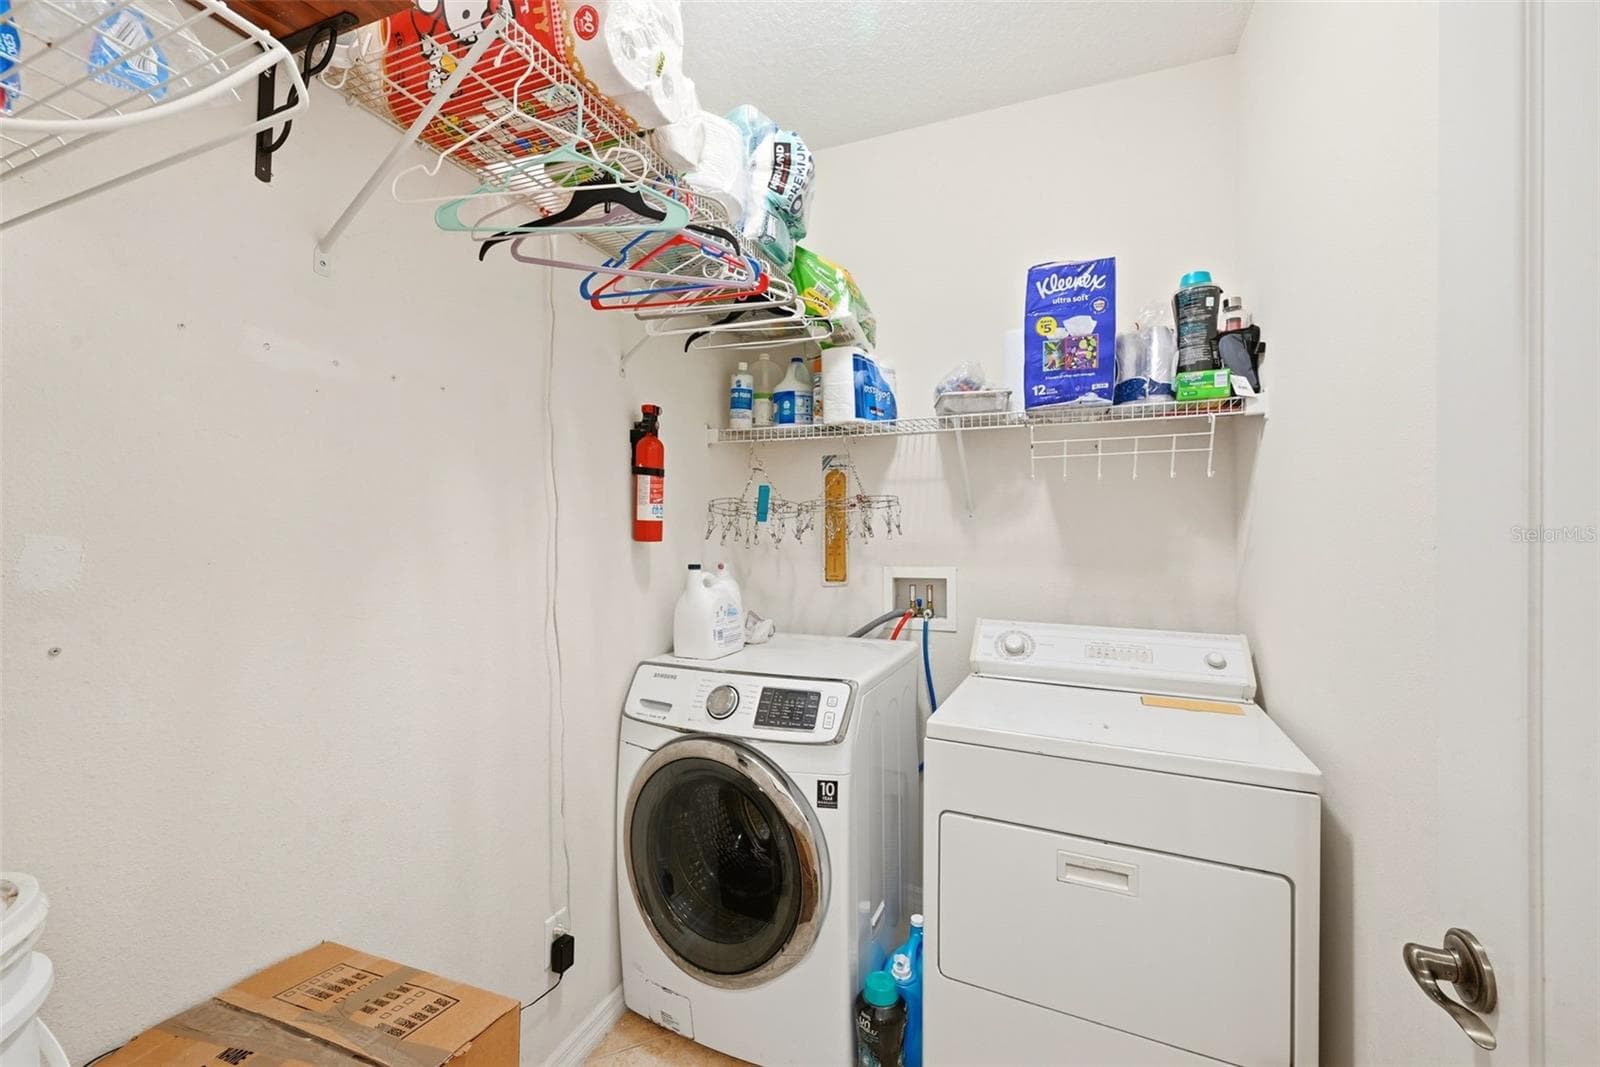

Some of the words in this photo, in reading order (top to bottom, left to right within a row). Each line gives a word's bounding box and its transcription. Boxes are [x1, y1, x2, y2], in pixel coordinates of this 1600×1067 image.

[583, 11, 595, 32] 40
[1036, 273, 1106, 299] Kleenex
[1052, 296, 1072, 304] ultra
[1073, 294, 1089, 303] soft
[1032, 385, 1046, 396] 12
[819, 782, 836, 797] 10
